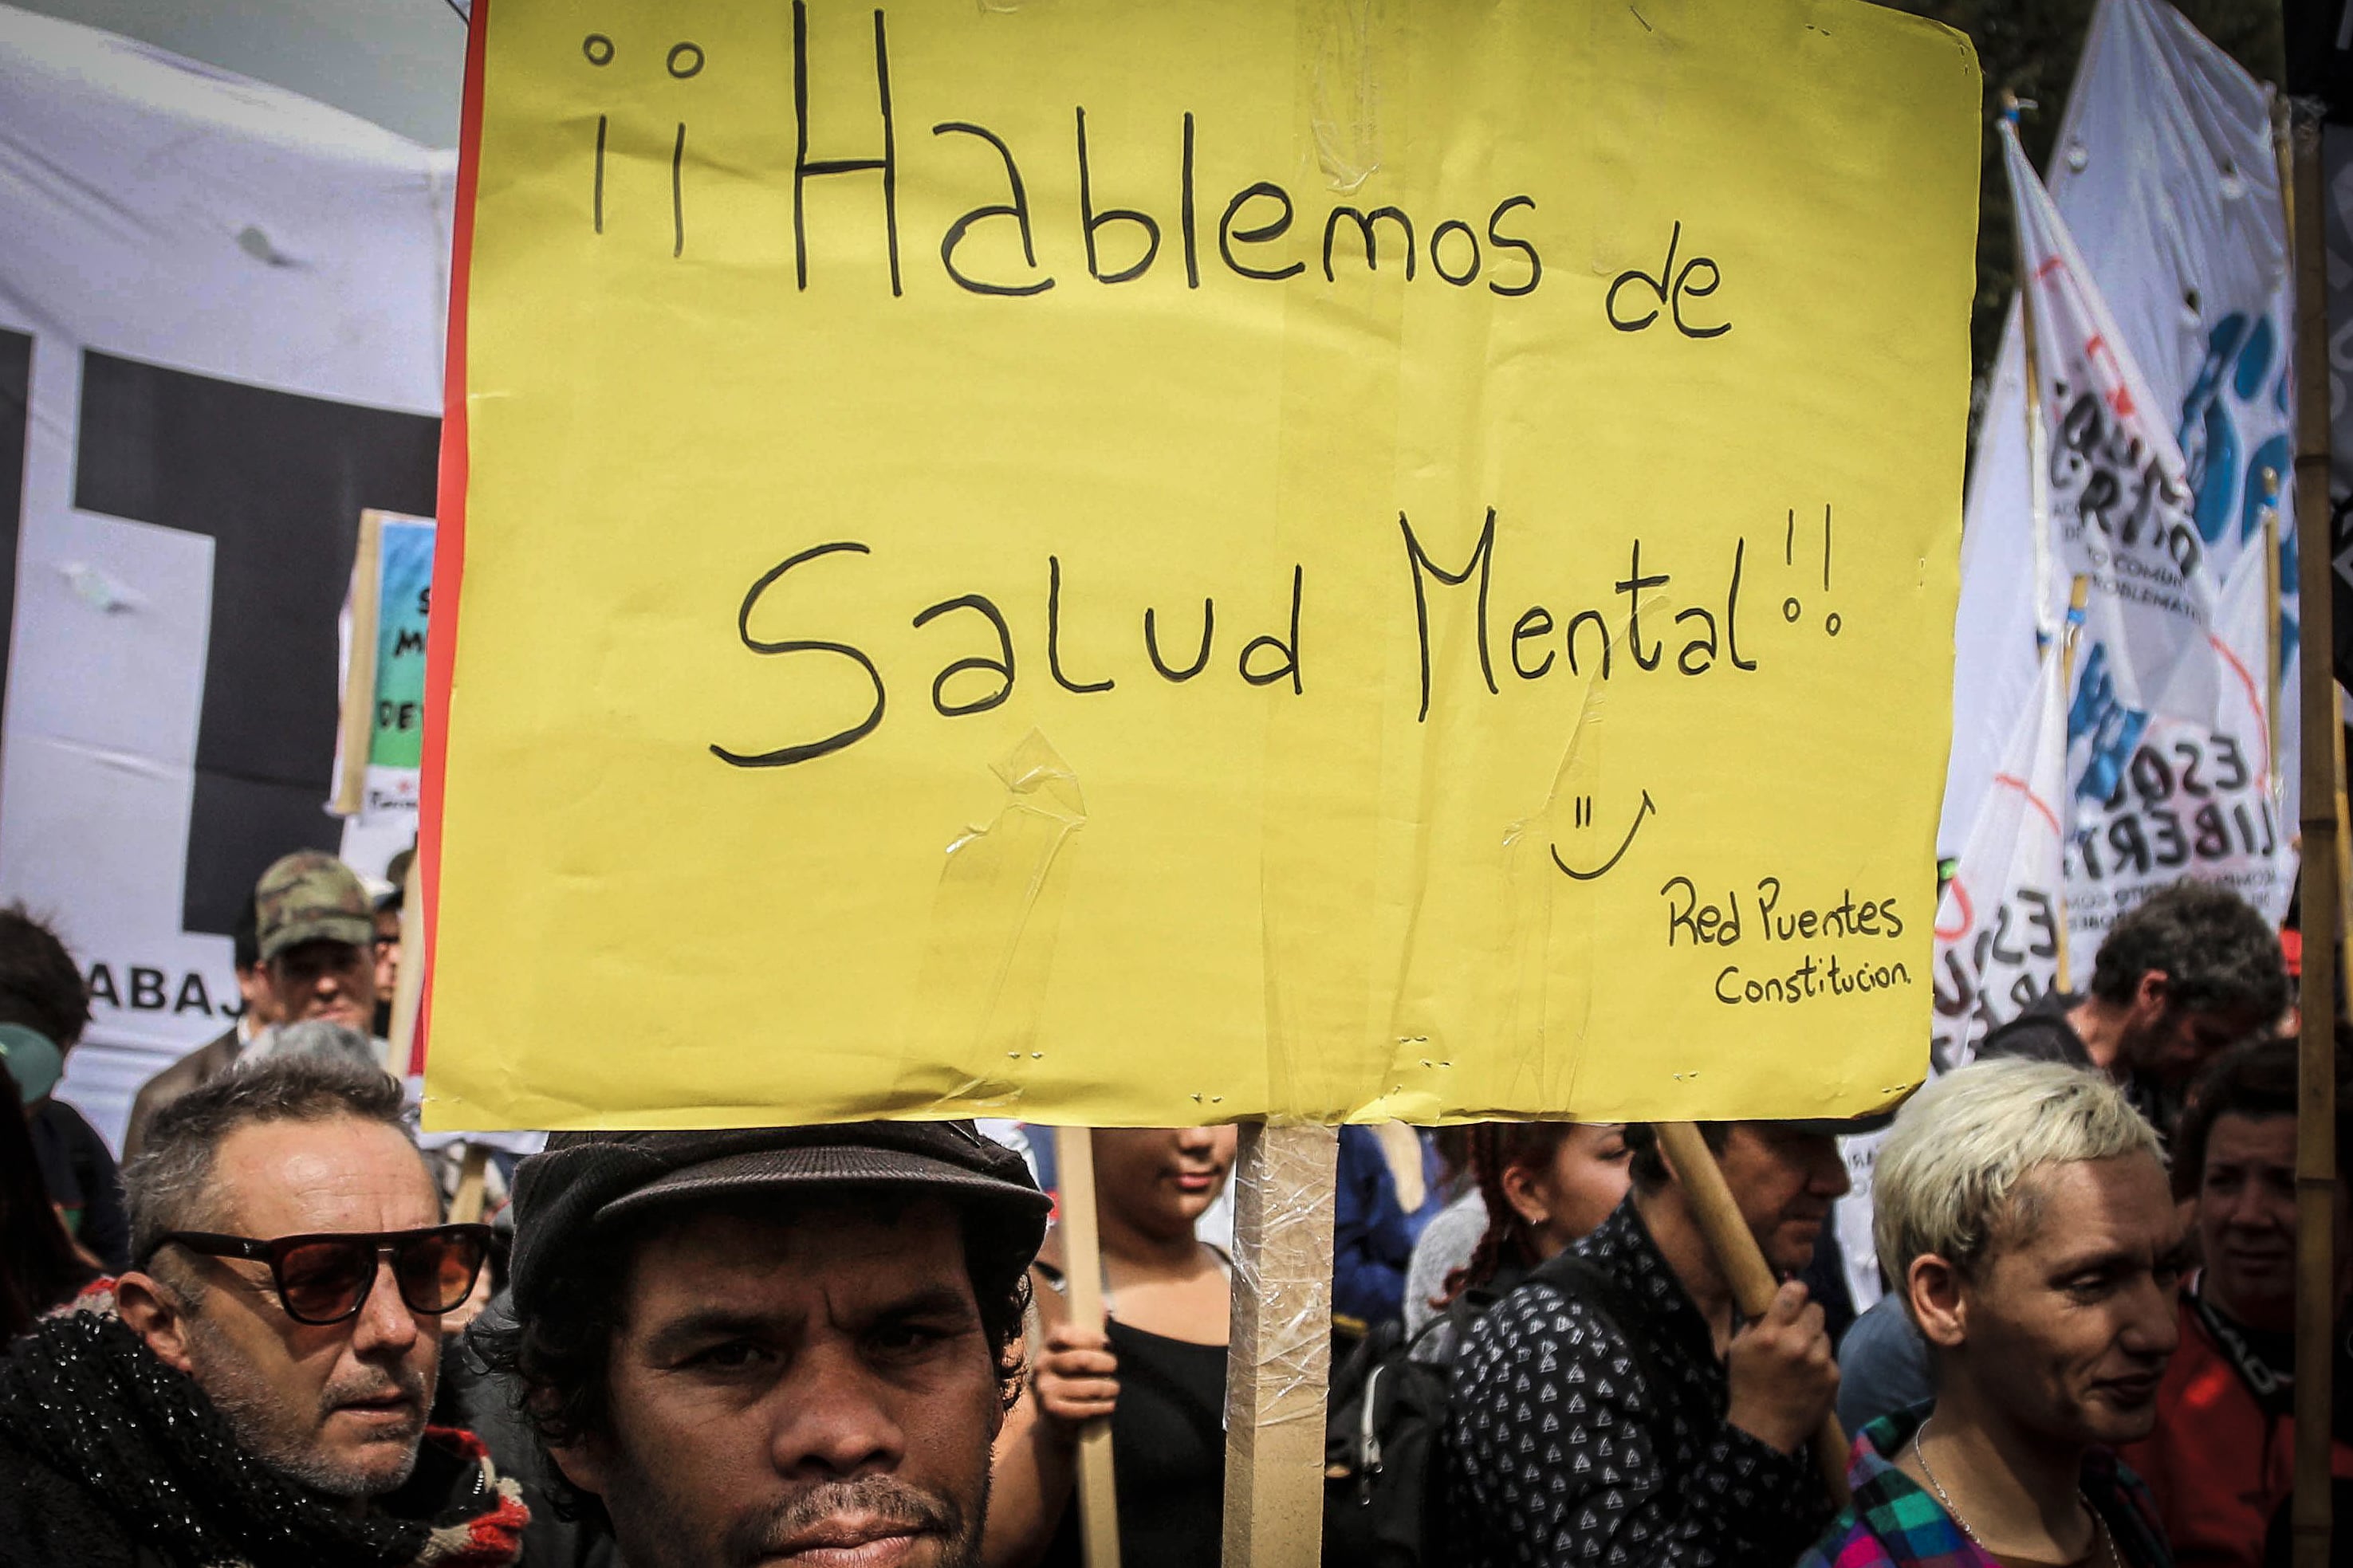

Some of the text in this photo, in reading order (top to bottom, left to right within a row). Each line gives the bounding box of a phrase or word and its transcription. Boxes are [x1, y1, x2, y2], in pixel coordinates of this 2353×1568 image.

[1605, 220, 1732, 338] de
[709, 541, 1304, 768] Salud
[1660, 876, 1903, 947] Red Puentes
